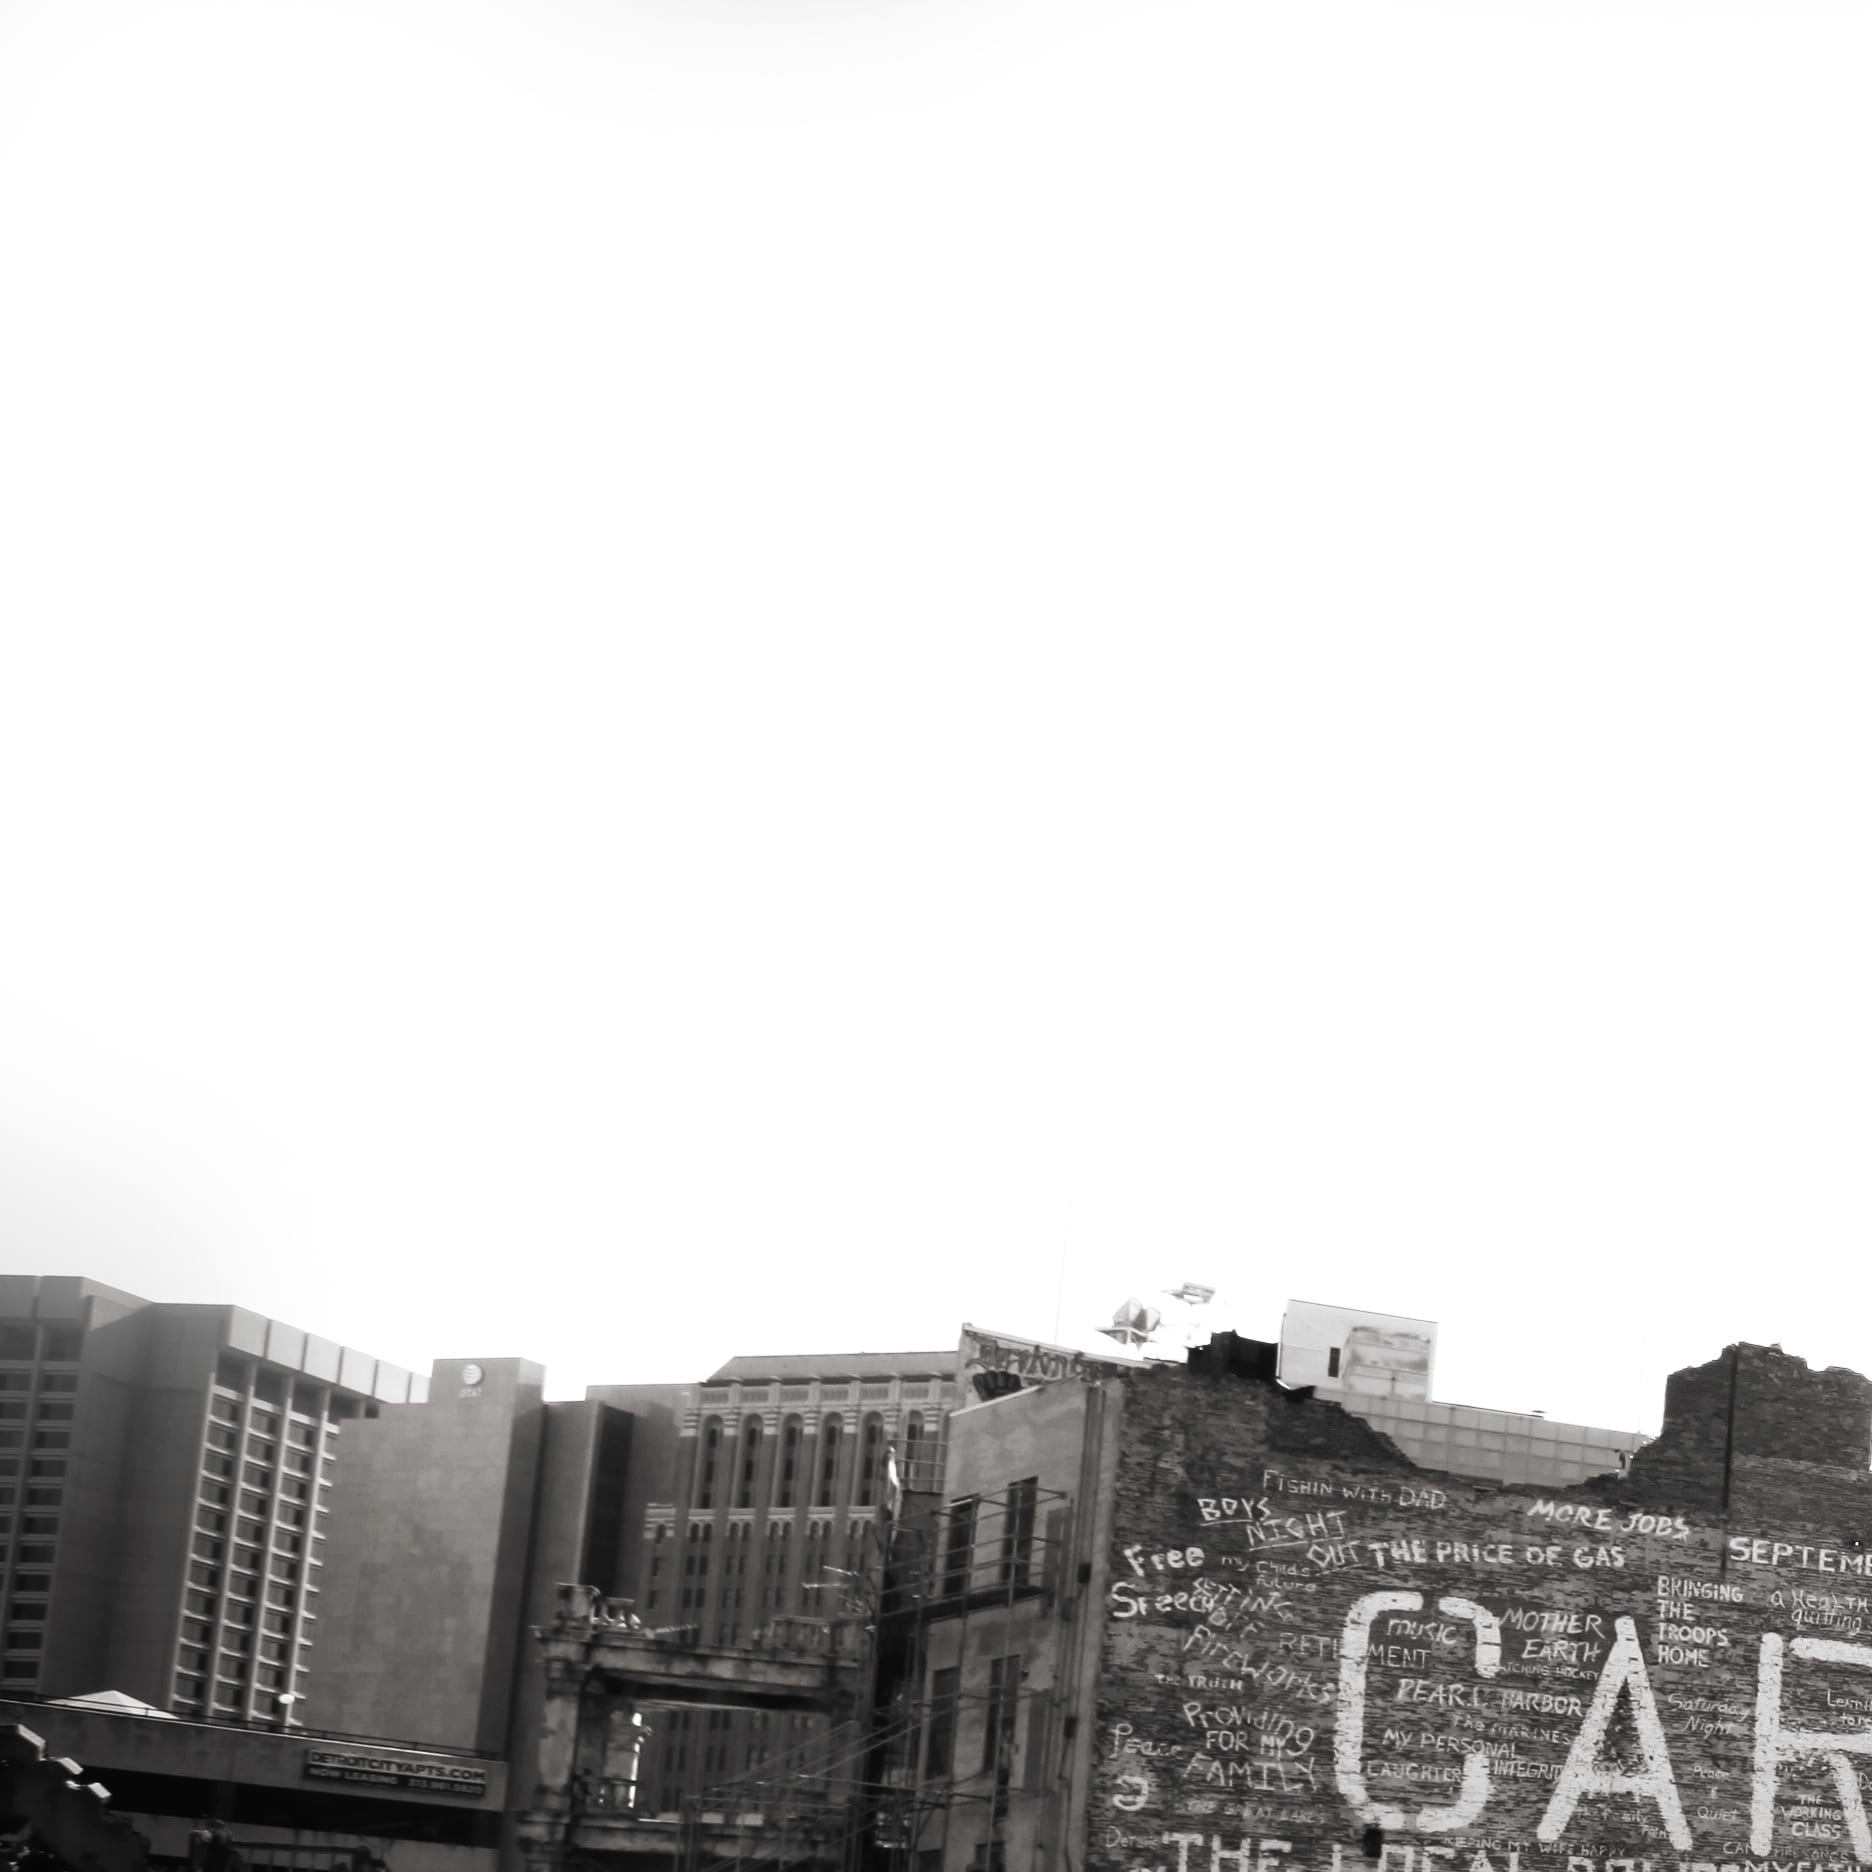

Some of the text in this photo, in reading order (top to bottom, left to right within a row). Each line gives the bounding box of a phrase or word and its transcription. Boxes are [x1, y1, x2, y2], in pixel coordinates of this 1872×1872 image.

[1198, 1498, 1272, 1522] BOYS
[1399, 1487, 1447, 1509] DAD
[1246, 1510, 1347, 1547] NIGHT
[1527, 1499, 1690, 1542] MORE JOBS
[1122, 1544, 1205, 1577] Free
[1307, 1540, 1361, 1568] OUT
[1368, 1539, 1625, 1569] THE PRICE OF GAS
[1656, 1575, 1744, 1603] BRINGING
[1501, 1607, 1606, 1640] MOTHER
[1656, 1599, 1697, 1622] THE
[1791, 1609, 1863, 1636] quitting
[1656, 1622, 1729, 1648] TROOPS
[1520, 1639, 1602, 1662] EARTH
[1657, 1645, 1711, 1669] HOME
[1396, 1678, 1584, 1718] PEARL HARBOR
[1182, 1701, 1315, 1757] Providing
[1684, 1714, 1734, 1740] Night
[1205, 1730, 1287, 1758] FOR MY
[1382, 1728, 1518, 1760] MY PERSONAL
[311, 1751, 487, 1781] DETROITCITYAPTS.COM
[344, 1770, 399, 1785] LEASING
[1181, 1752, 1317, 1792] FAMILY
[1367, 1760, 1462, 1784] LAUGHTER
[1697, 1804, 1742, 1823] Quiet
[1791, 1821, 1843, 1840] CLASS
